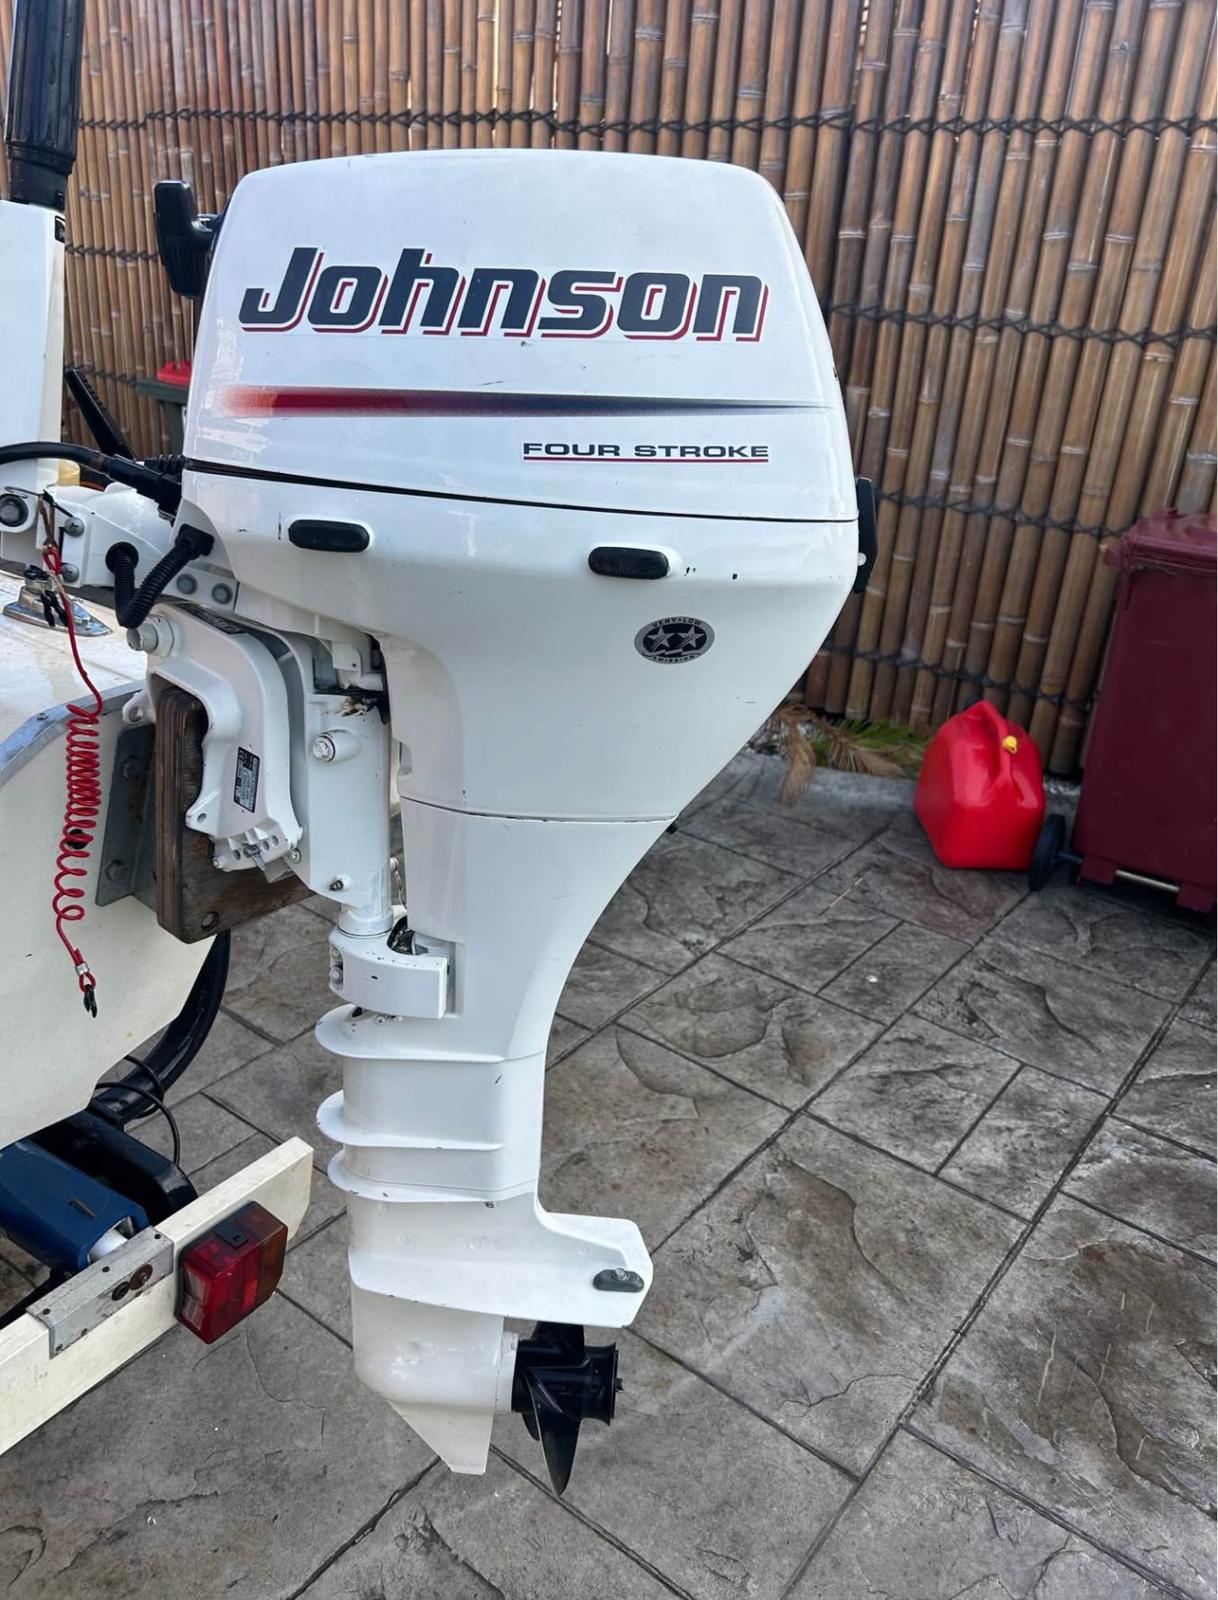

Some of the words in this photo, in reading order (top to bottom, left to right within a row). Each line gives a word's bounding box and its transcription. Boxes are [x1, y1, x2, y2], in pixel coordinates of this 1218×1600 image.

[239, 247, 769, 342] Johnson
[523, 442, 621, 457] FOUR
[633, 444, 769, 459] STROKE
